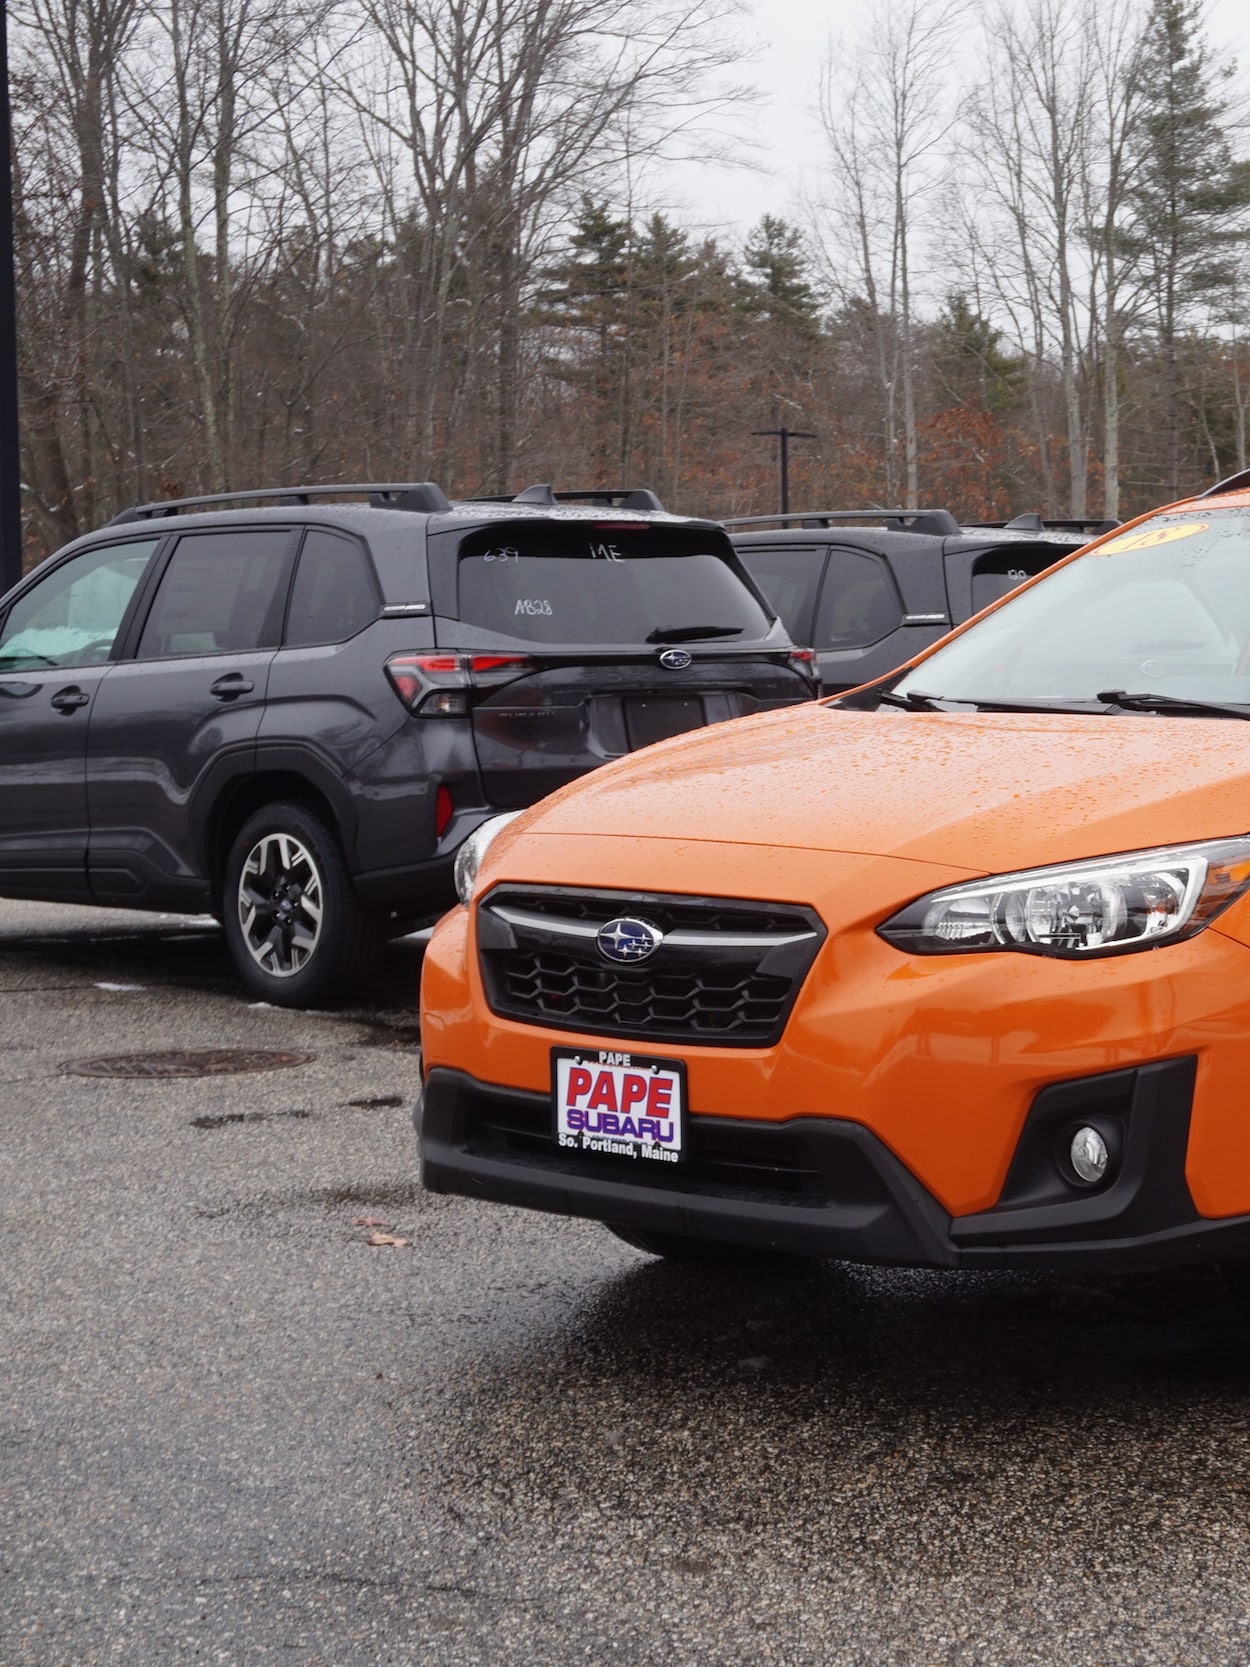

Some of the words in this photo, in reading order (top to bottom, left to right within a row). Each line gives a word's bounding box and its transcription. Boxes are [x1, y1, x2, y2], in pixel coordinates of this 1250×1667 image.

[598, 1051, 631, 1067] PAPE
[566, 1067, 674, 1119] PAPE
[566, 1109, 674, 1143] SUBARU
[558, 1133, 578, 1149] So.
[582, 1135, 637, 1159] Portland,
[641, 1144, 679, 1163] Maine
